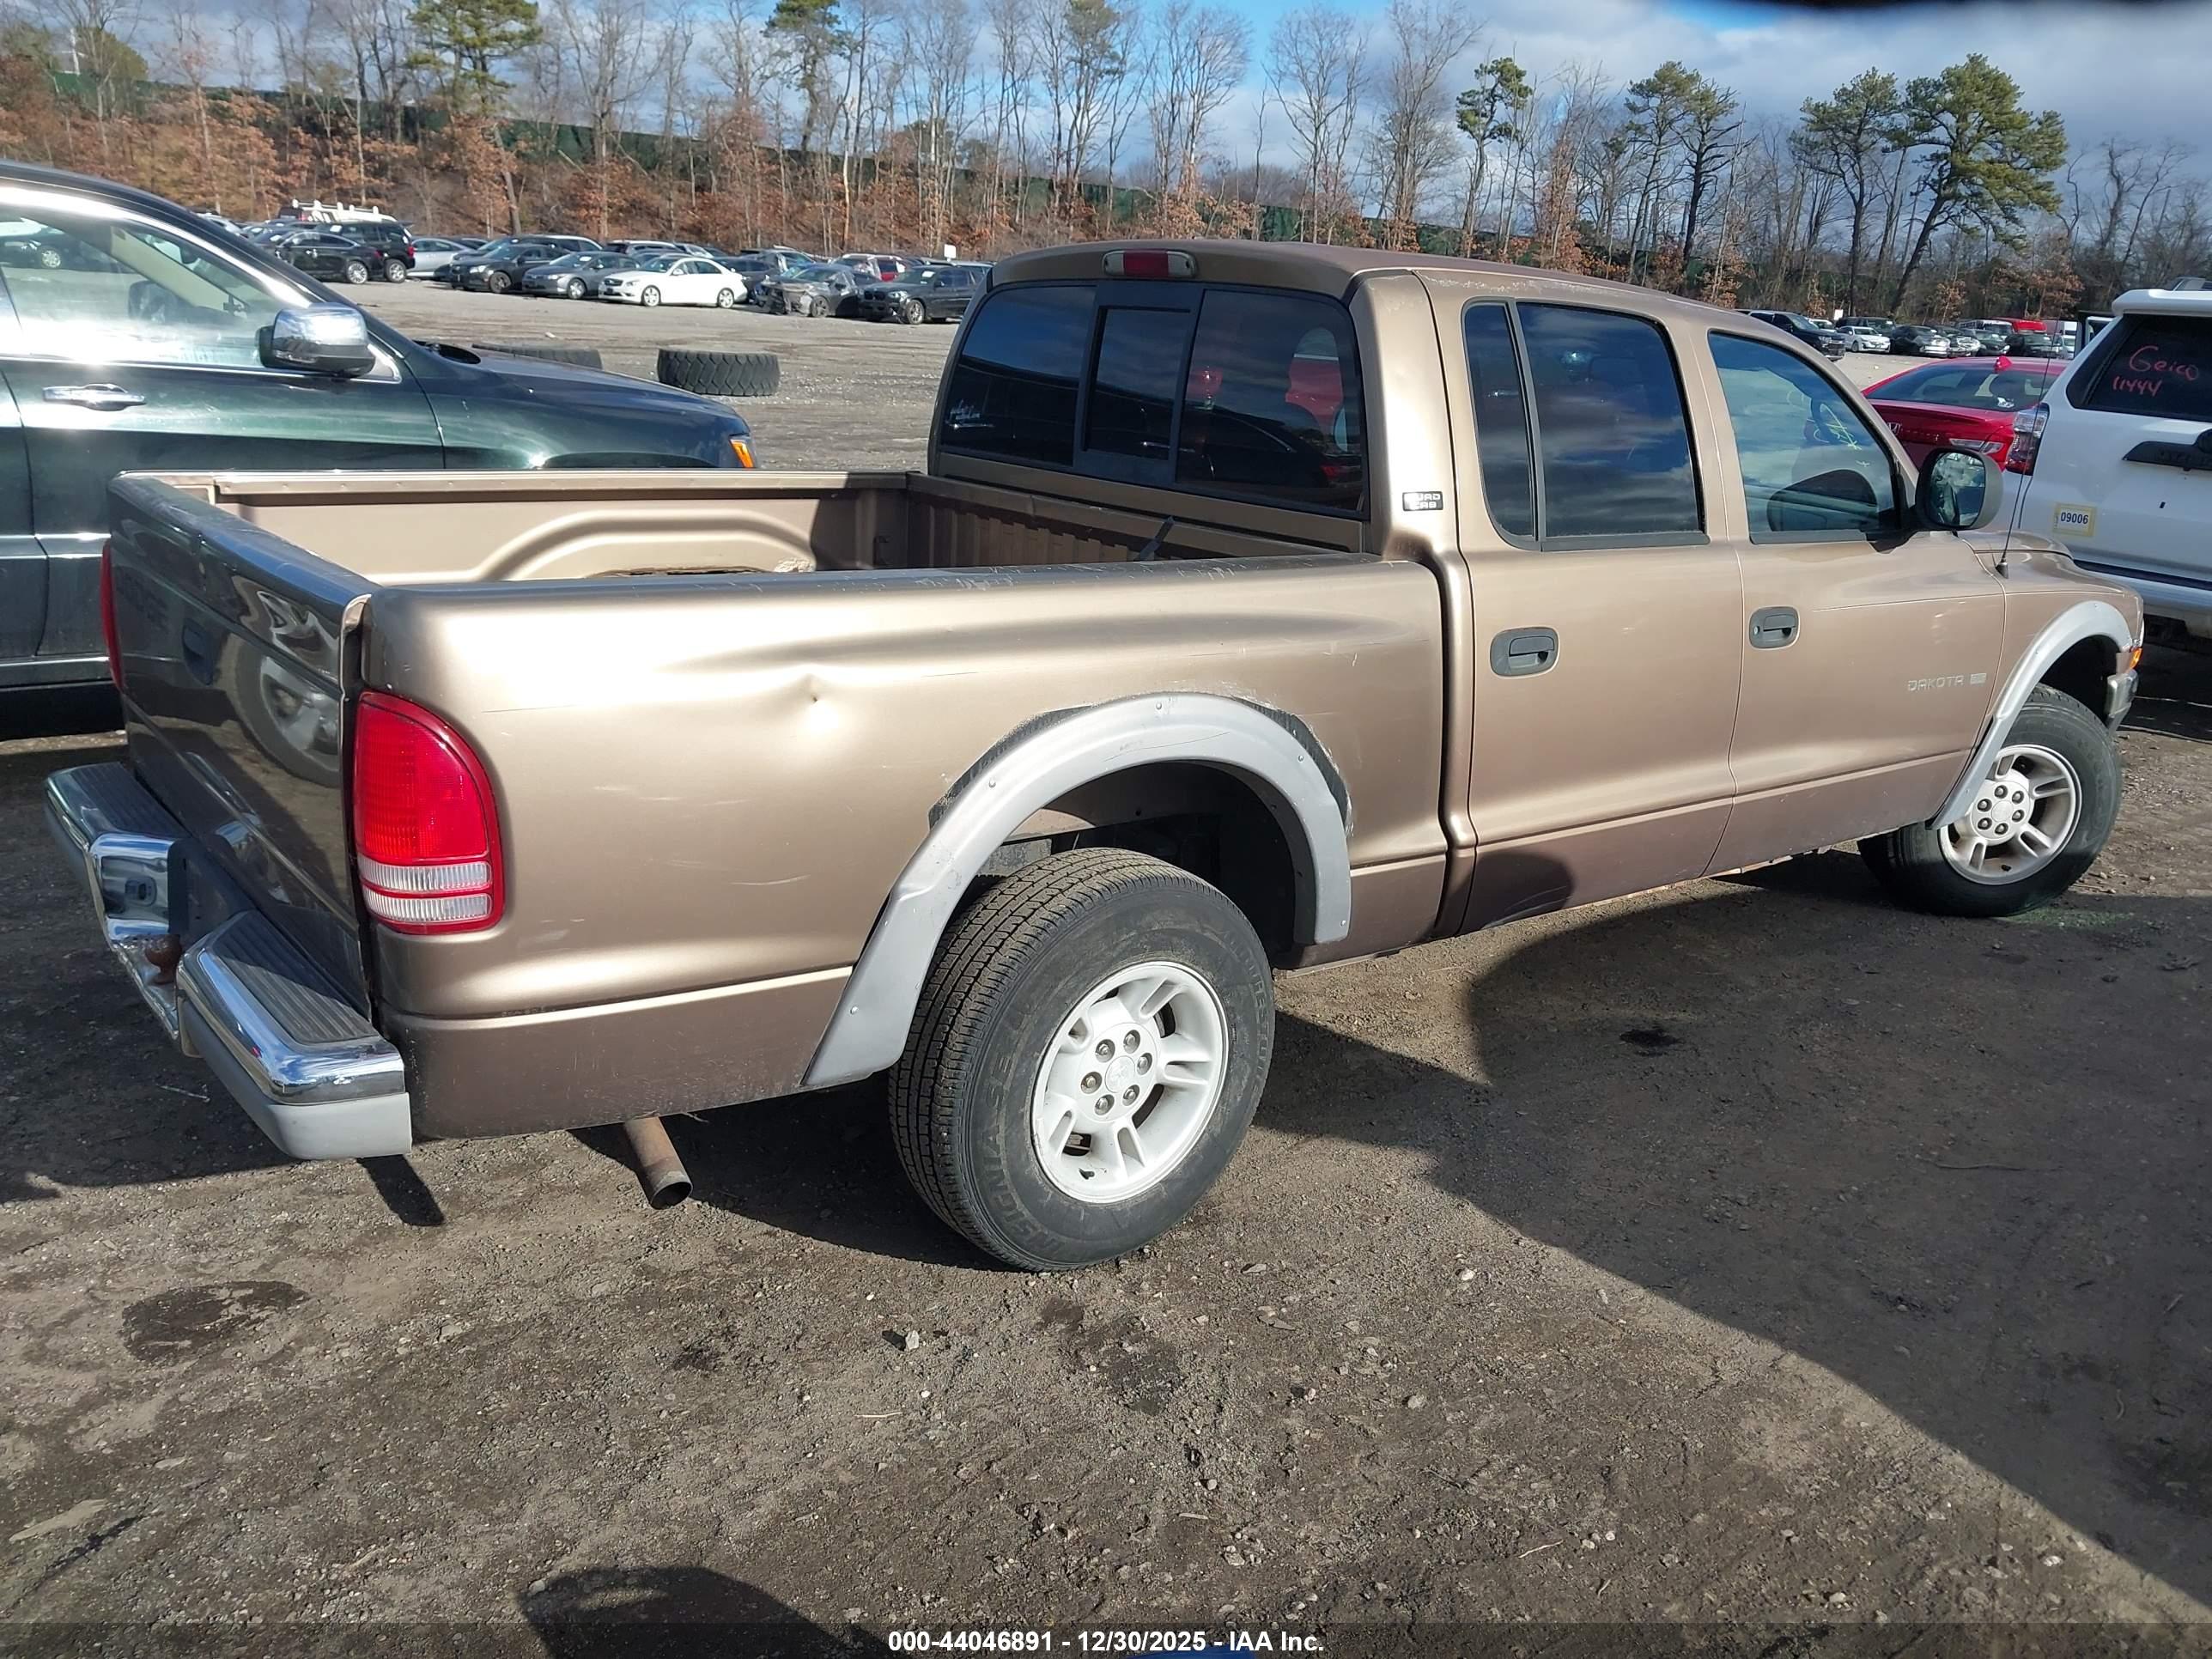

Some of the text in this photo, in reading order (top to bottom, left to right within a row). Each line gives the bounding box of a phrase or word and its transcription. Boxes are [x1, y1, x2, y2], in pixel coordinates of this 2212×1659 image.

[2130, 345, 2199, 381] Geico
[2061, 512, 2089, 525] 09006
[1908, 675, 1965, 691] DAKOTA
